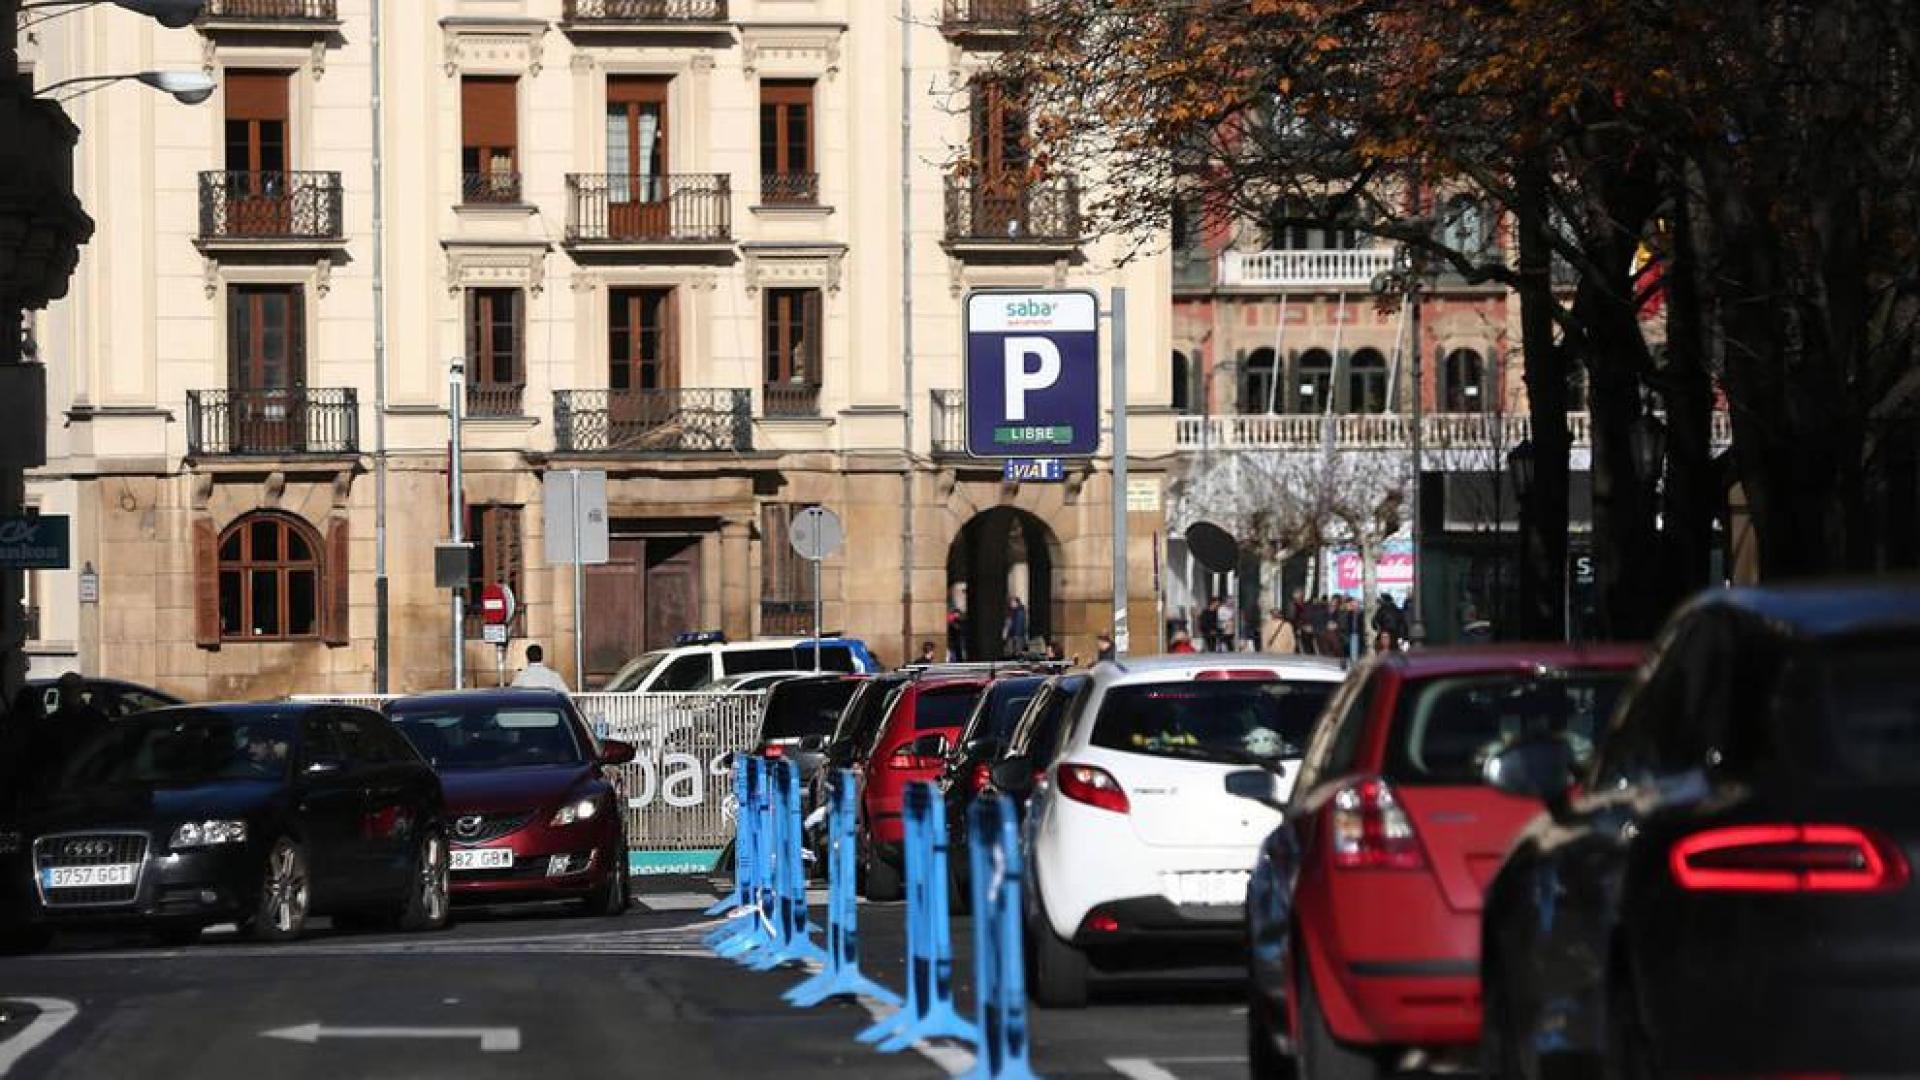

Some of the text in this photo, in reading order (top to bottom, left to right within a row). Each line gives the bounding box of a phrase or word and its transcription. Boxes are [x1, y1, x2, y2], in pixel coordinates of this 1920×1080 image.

[1006, 298, 1052, 316] saba
[1004, 336, 1061, 421] P
[1011, 427, 1055, 439] LIBRE
[54, 866, 128, 885] 3757 GCT
